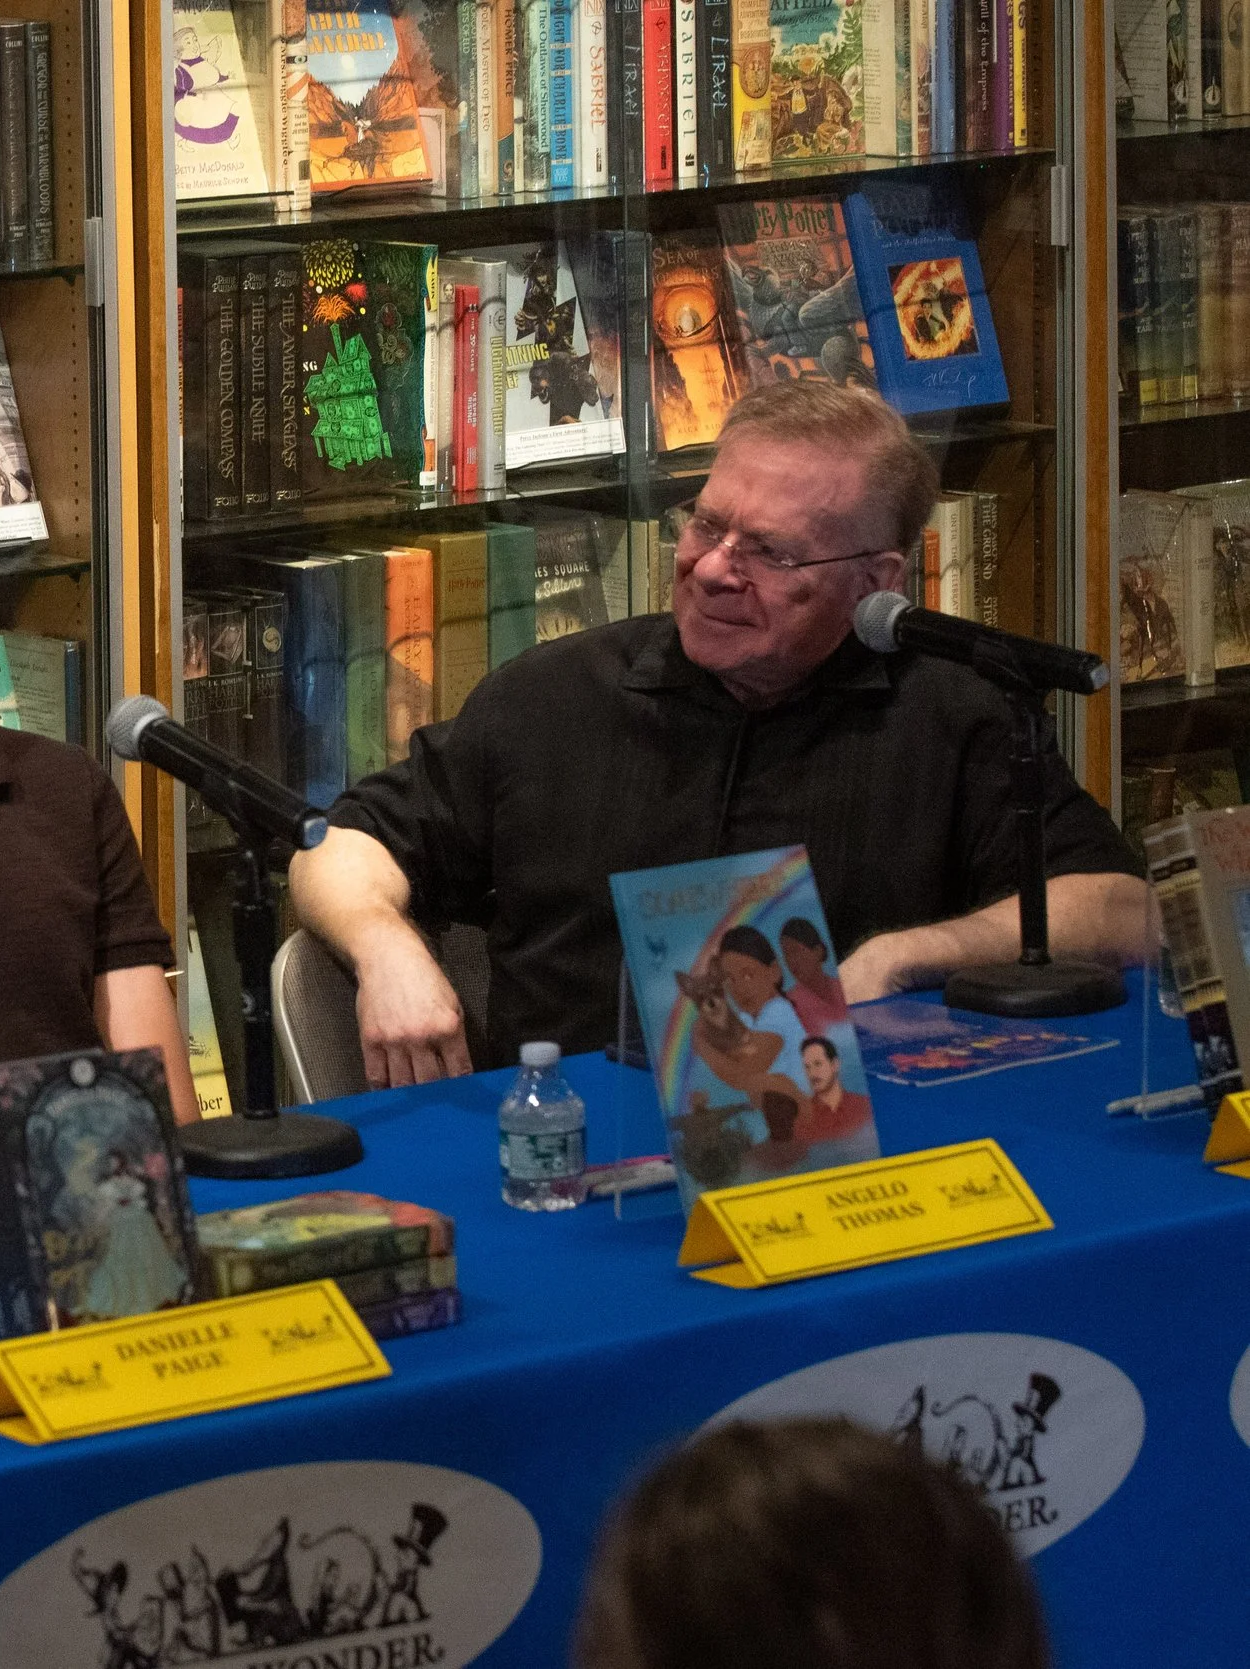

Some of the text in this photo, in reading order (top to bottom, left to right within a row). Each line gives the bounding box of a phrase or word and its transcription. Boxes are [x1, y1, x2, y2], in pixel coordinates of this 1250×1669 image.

[280, 46, 289, 75] Mrs.
[462, 33, 471, 54] ELD
[479, 38, 492, 86] MASTER
[504, 9, 514, 98] HOMER PRICE
[36, 52, 49, 90] GREGOR
[539, 8, 549, 149] The Outlaws of Sherwood
[977, 22, 991, 112] of the Empress
[36, 99, 48, 133] CURSE
[552, 48, 568, 160] FOR CHARLIE BONE
[174, 162, 195, 176] BETTY
[776, 199, 836, 238] Potter
[651, 248, 699, 269] SEA OF
[469, 333, 477, 347] 39
[250, 295, 267, 446] THE SUBTLE KNIFE
[279, 292, 299, 474] THE AMBER SPYGLASS
[490, 335, 505, 437] LIGHTNING THIEF
[218, 298, 237, 487] THE GOLDEN COMPASS
[950, 513, 959, 564] UNTIL THE
[982, 503, 992, 581] THE GROUND
[543, 576, 583, 599] Selden
[553, 560, 590, 578] SQUARE
[412, 597, 422, 661] HARRY
[825, 1178, 910, 1211] ANGELO
[832, 1200, 927, 1233] THOMAS
[114, 1320, 232, 1362] DANIELLE
[152, 1349, 227, 1381] PAIGE
